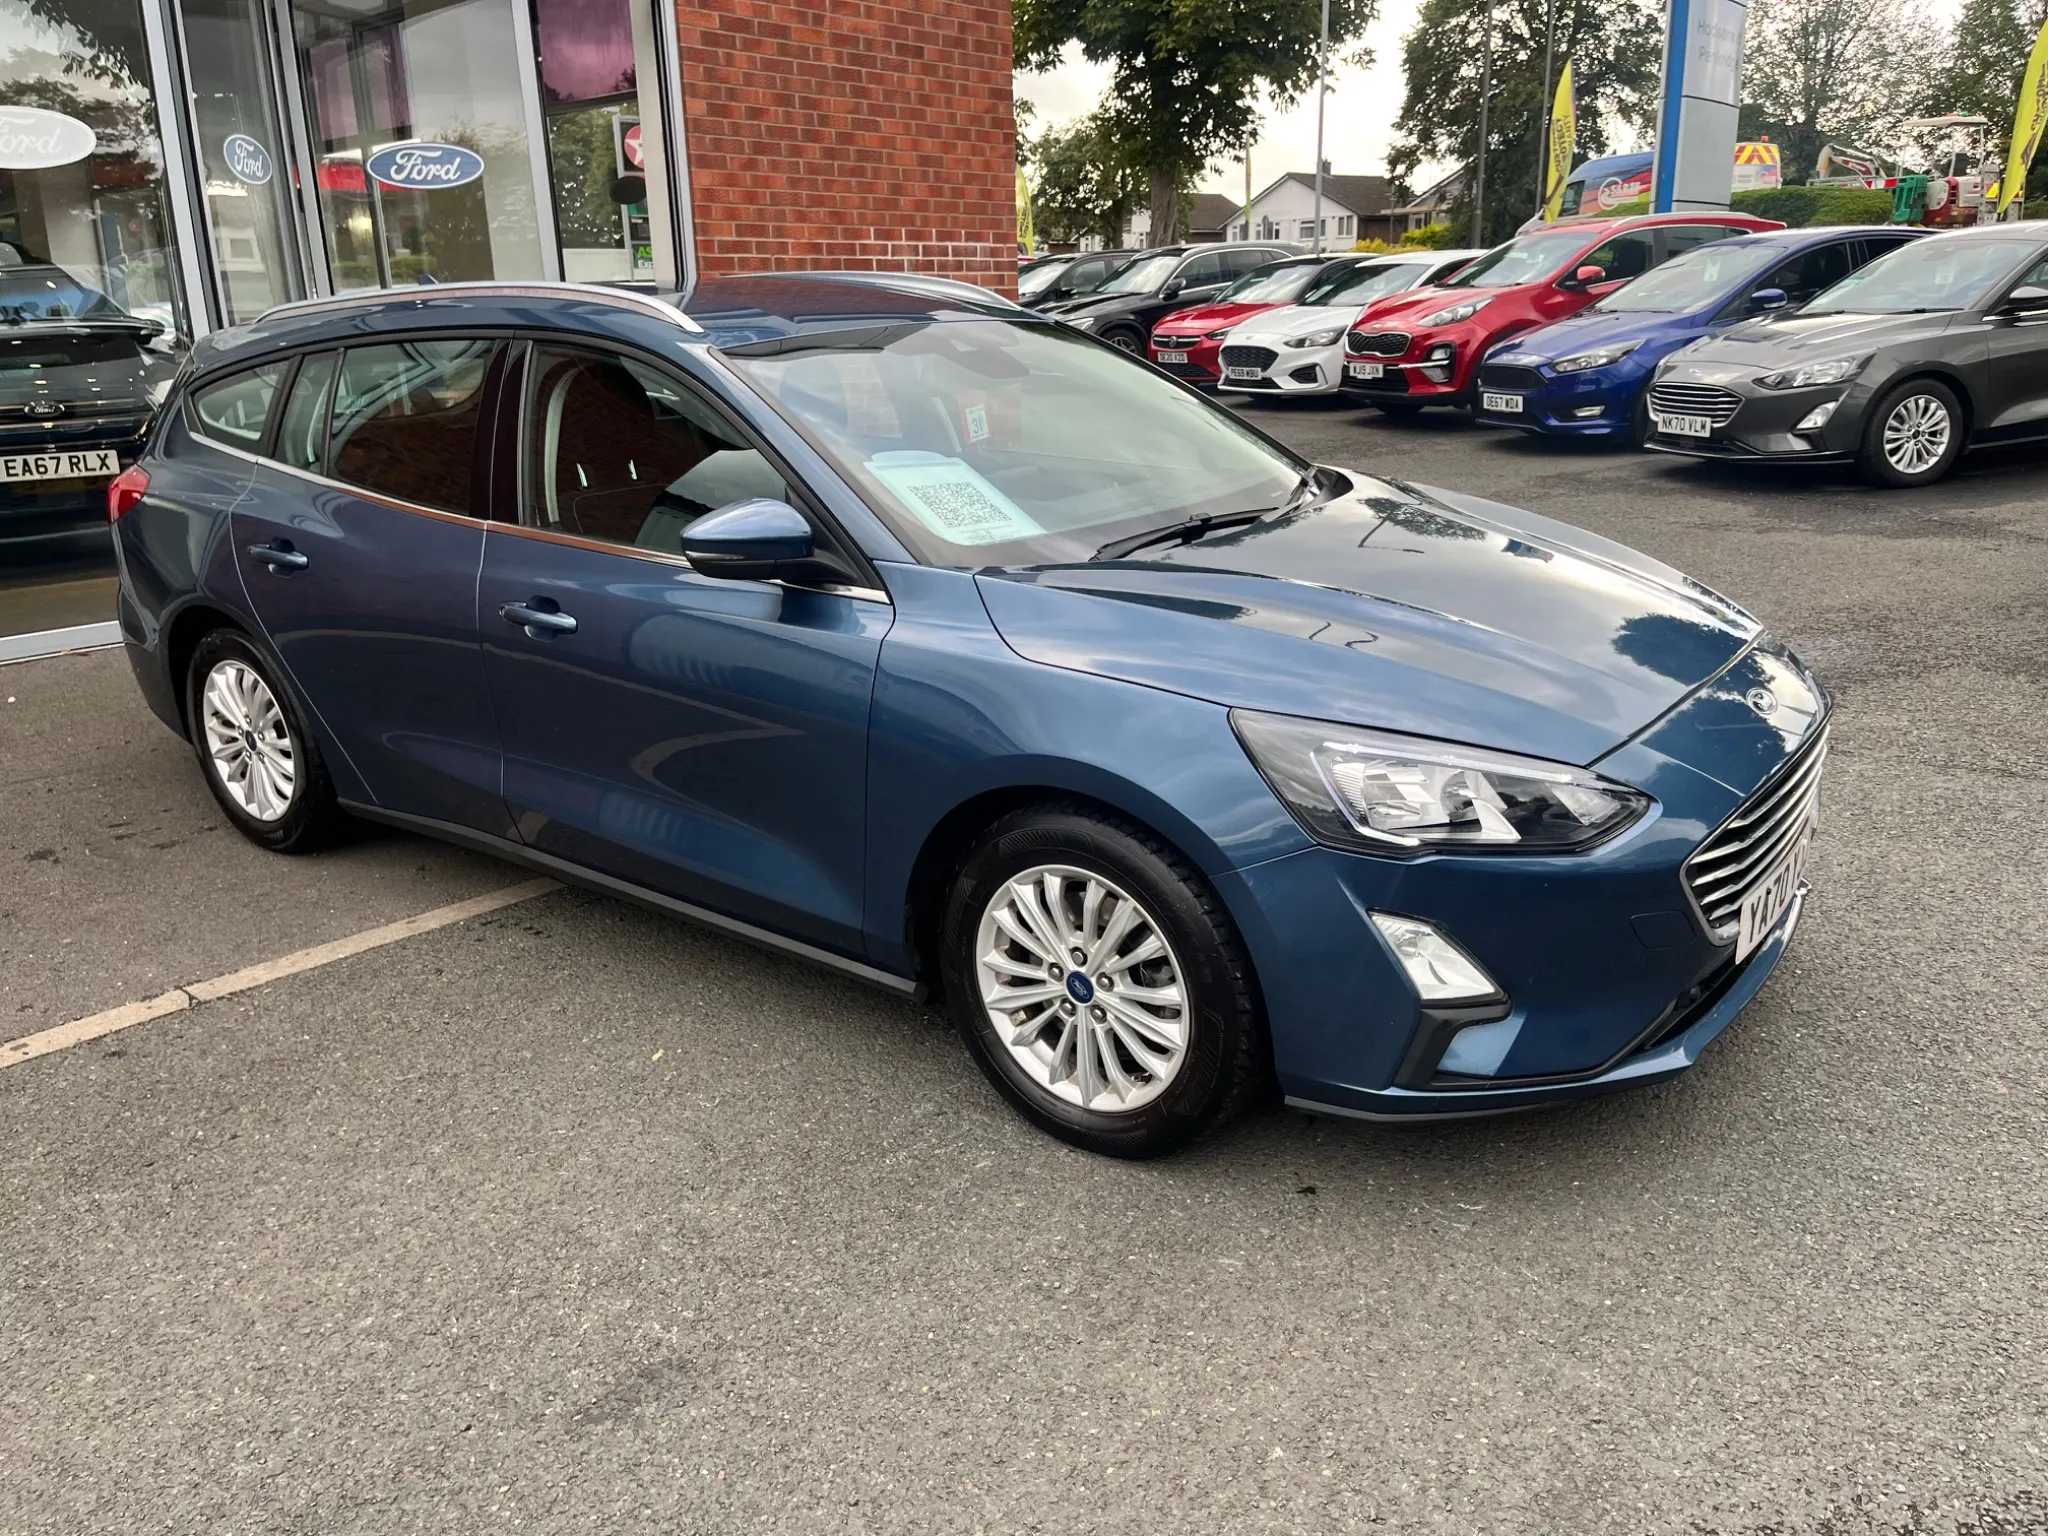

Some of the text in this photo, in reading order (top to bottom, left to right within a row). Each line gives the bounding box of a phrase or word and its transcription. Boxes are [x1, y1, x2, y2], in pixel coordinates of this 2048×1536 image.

[235, 140, 264, 178] Ford
[390, 149, 461, 180] Ford
[1662, 415, 1707, 434] NK70 VLM
[4, 453, 111, 478] EA67 RLX
[1749, 862, 1791, 944] YA70
